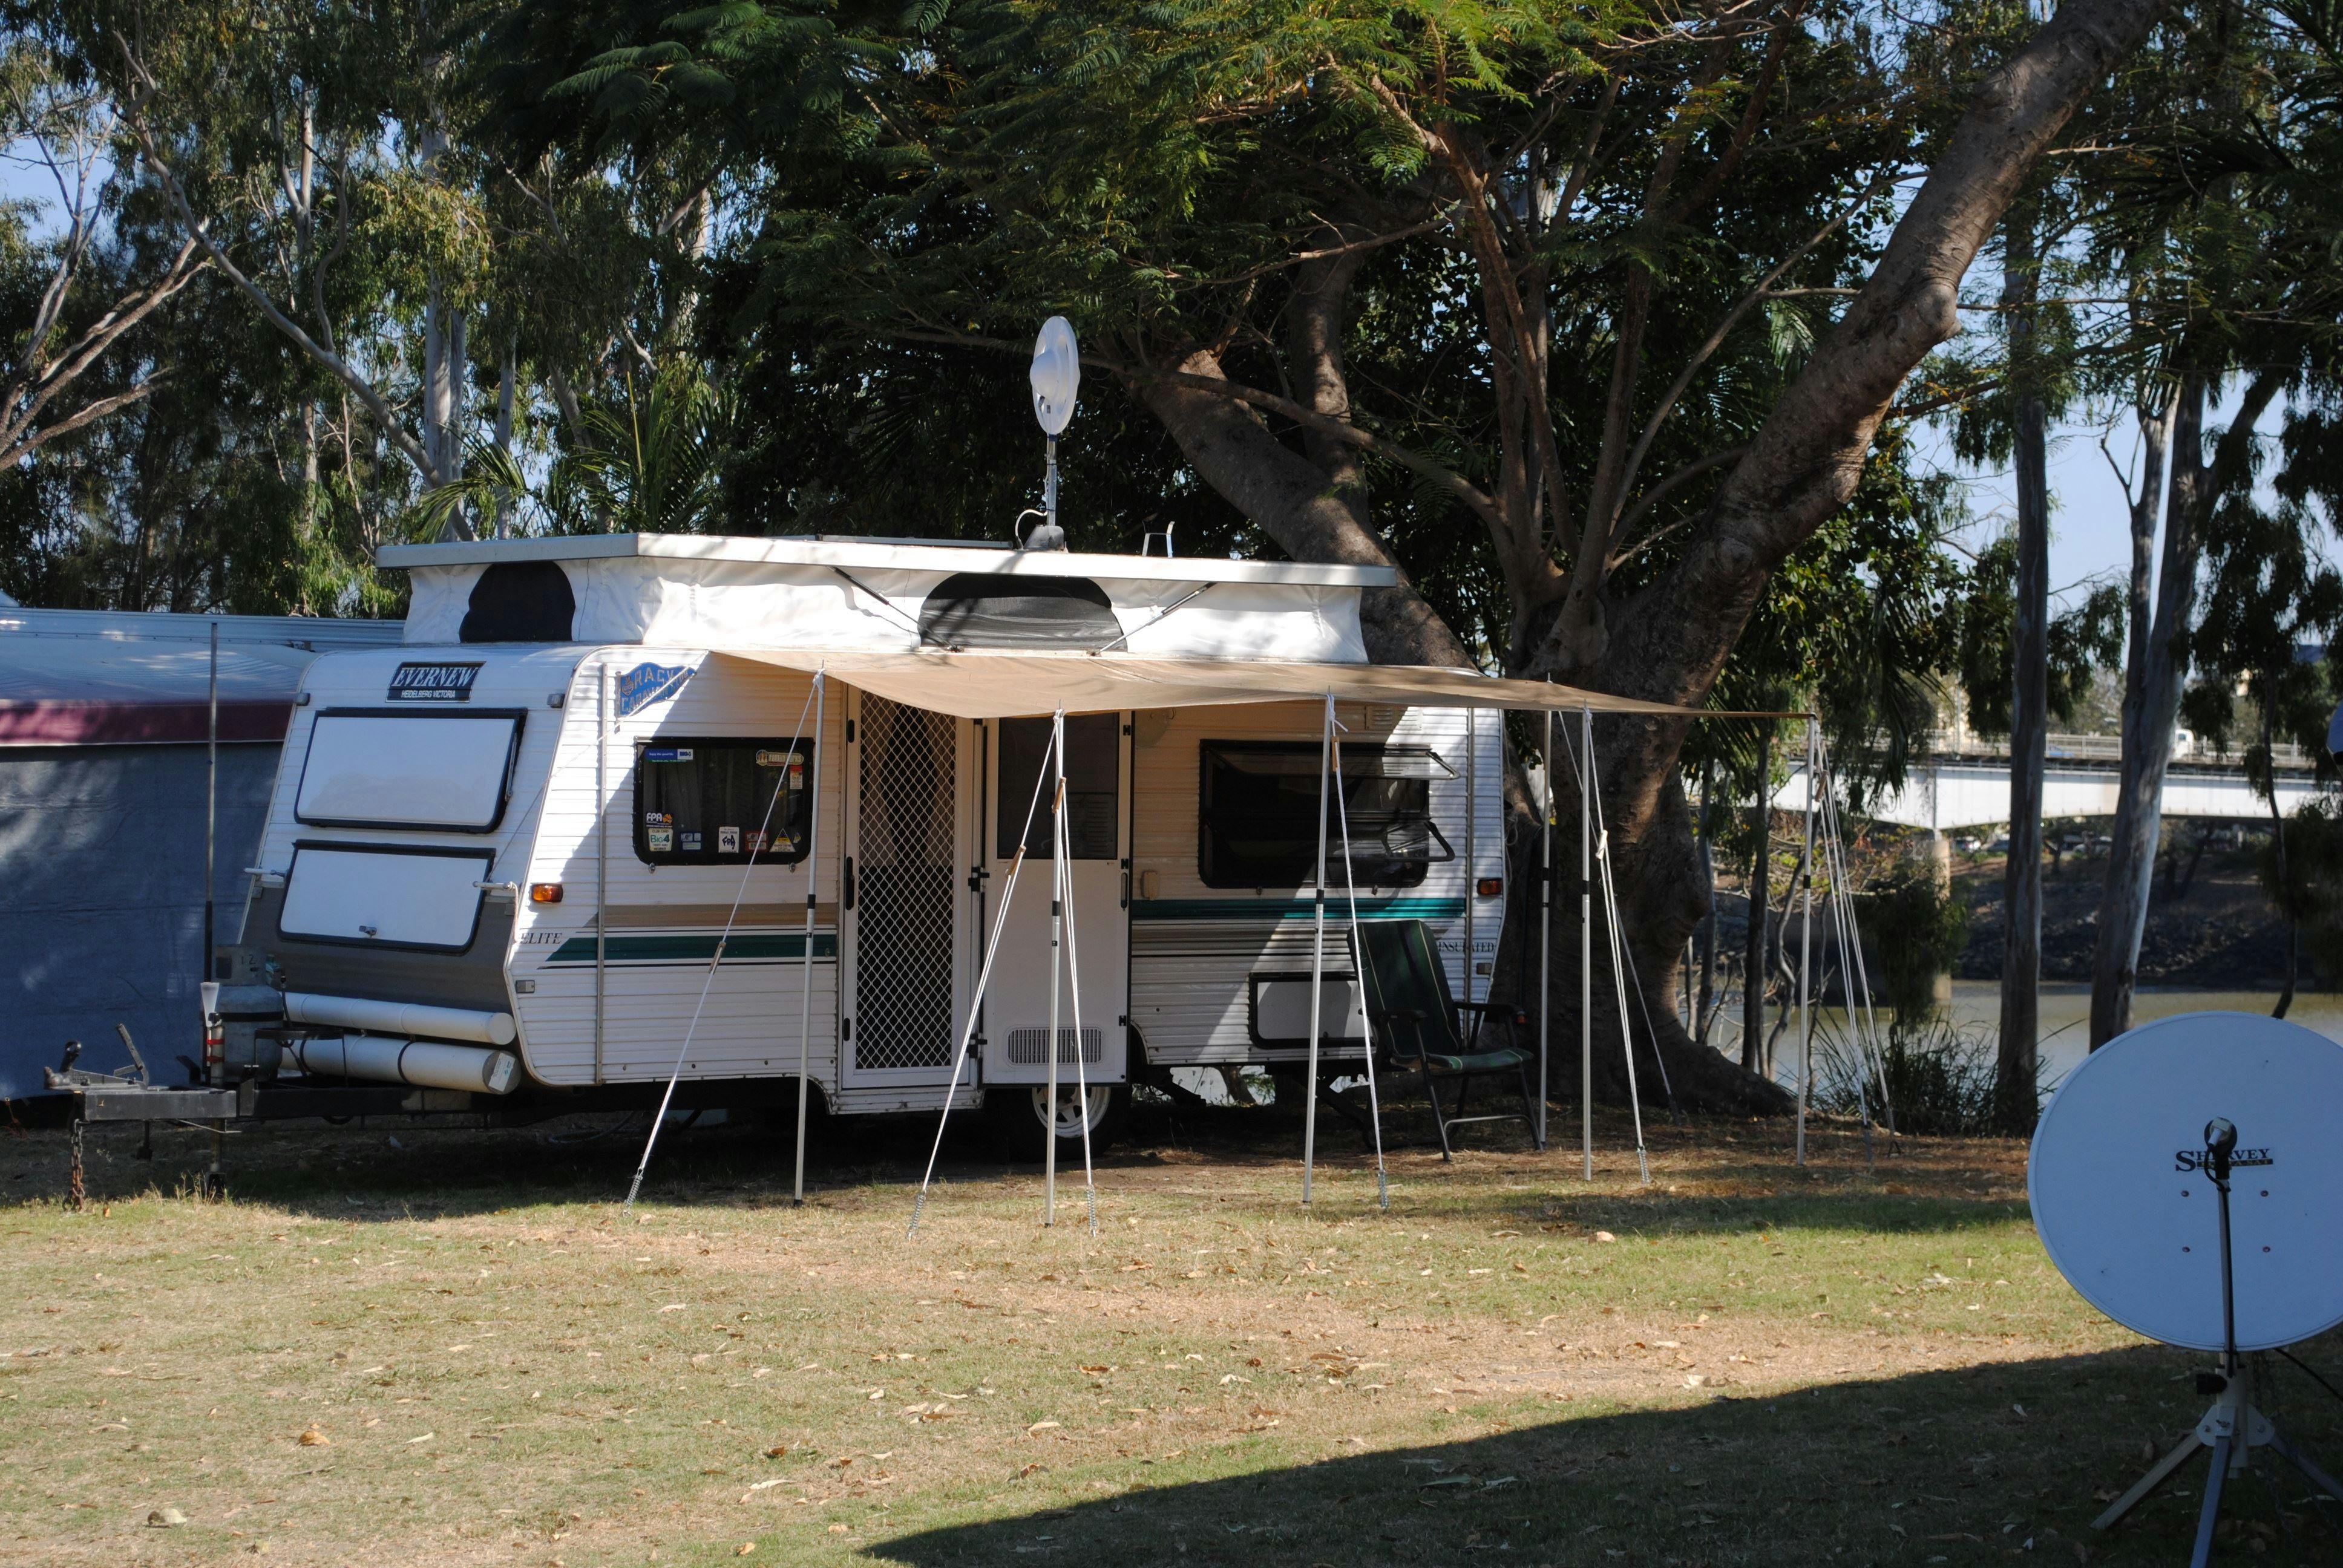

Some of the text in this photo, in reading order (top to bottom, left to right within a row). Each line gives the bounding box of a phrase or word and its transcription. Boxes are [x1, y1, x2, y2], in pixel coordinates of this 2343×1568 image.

[392, 667, 479, 687] EVERNEW
[401, 690, 456, 698] HEIDELBERG VICTORIA
[520, 932, 563, 944] ELITE
